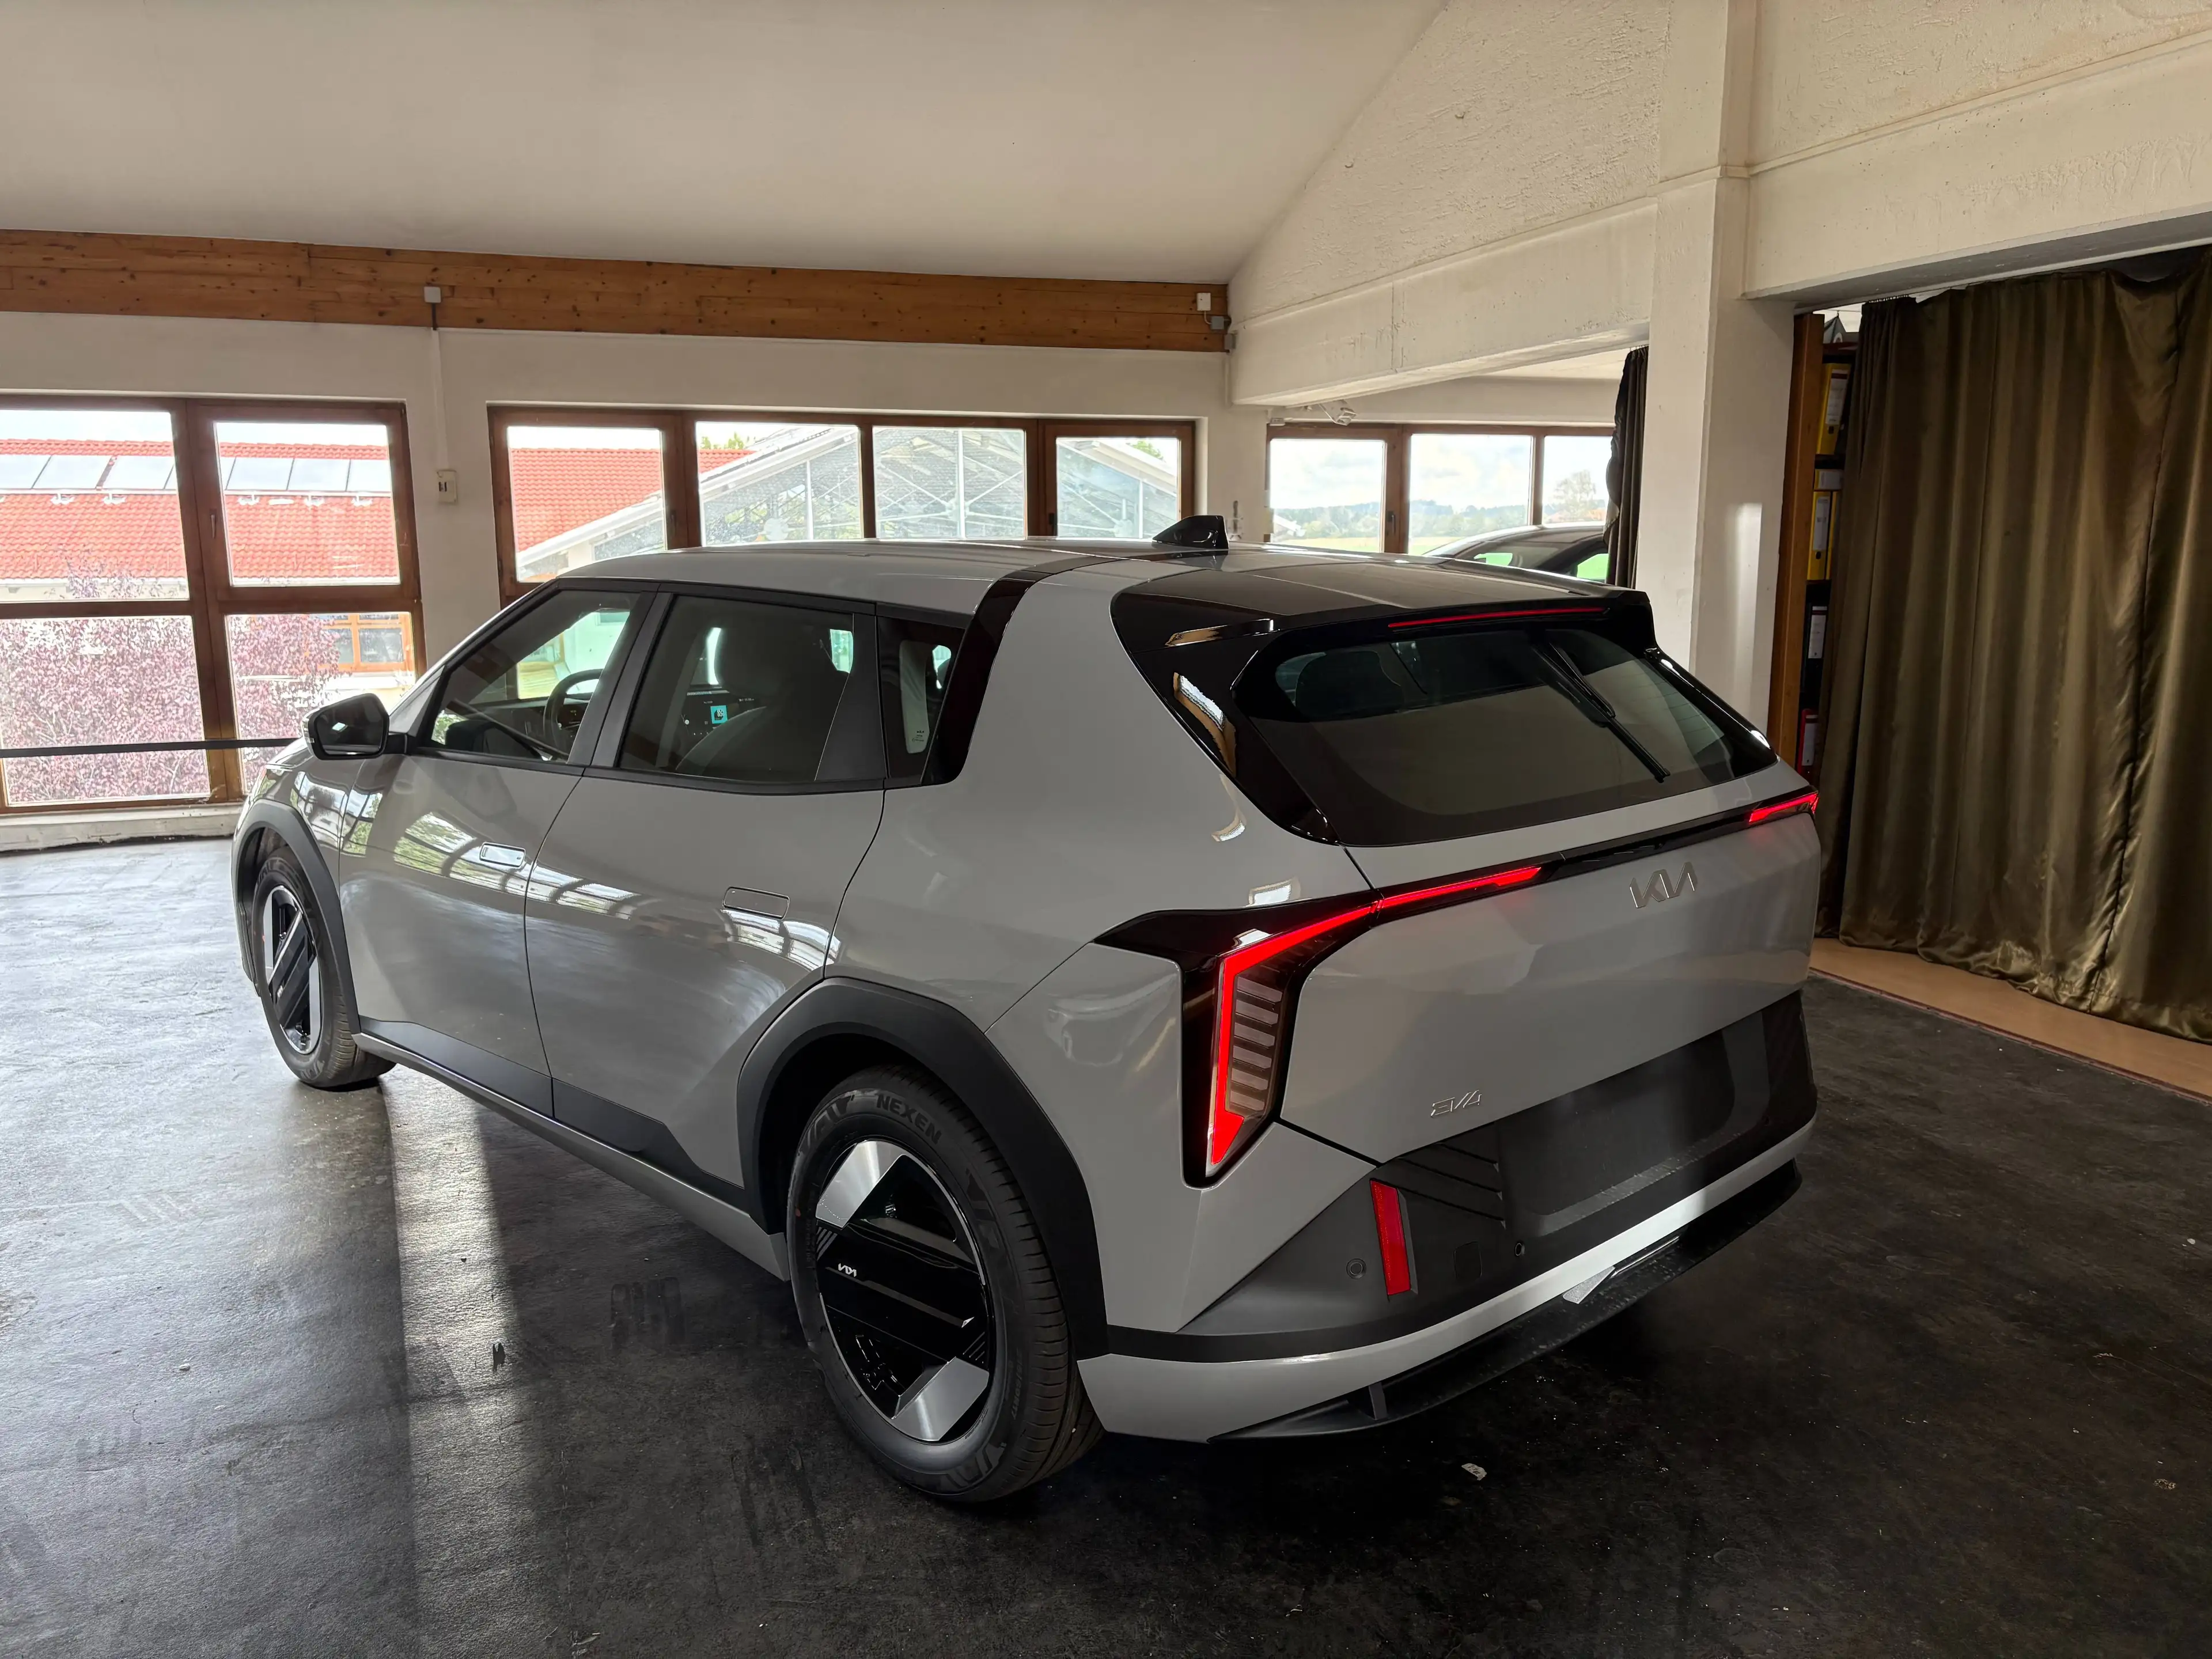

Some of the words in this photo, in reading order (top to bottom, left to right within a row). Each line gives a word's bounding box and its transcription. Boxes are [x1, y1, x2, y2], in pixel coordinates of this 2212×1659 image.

[1630, 862, 1698, 908] KIA
[877, 1094, 942, 1144] NEXEN
[1430, 1089, 1482, 1117] EV4
